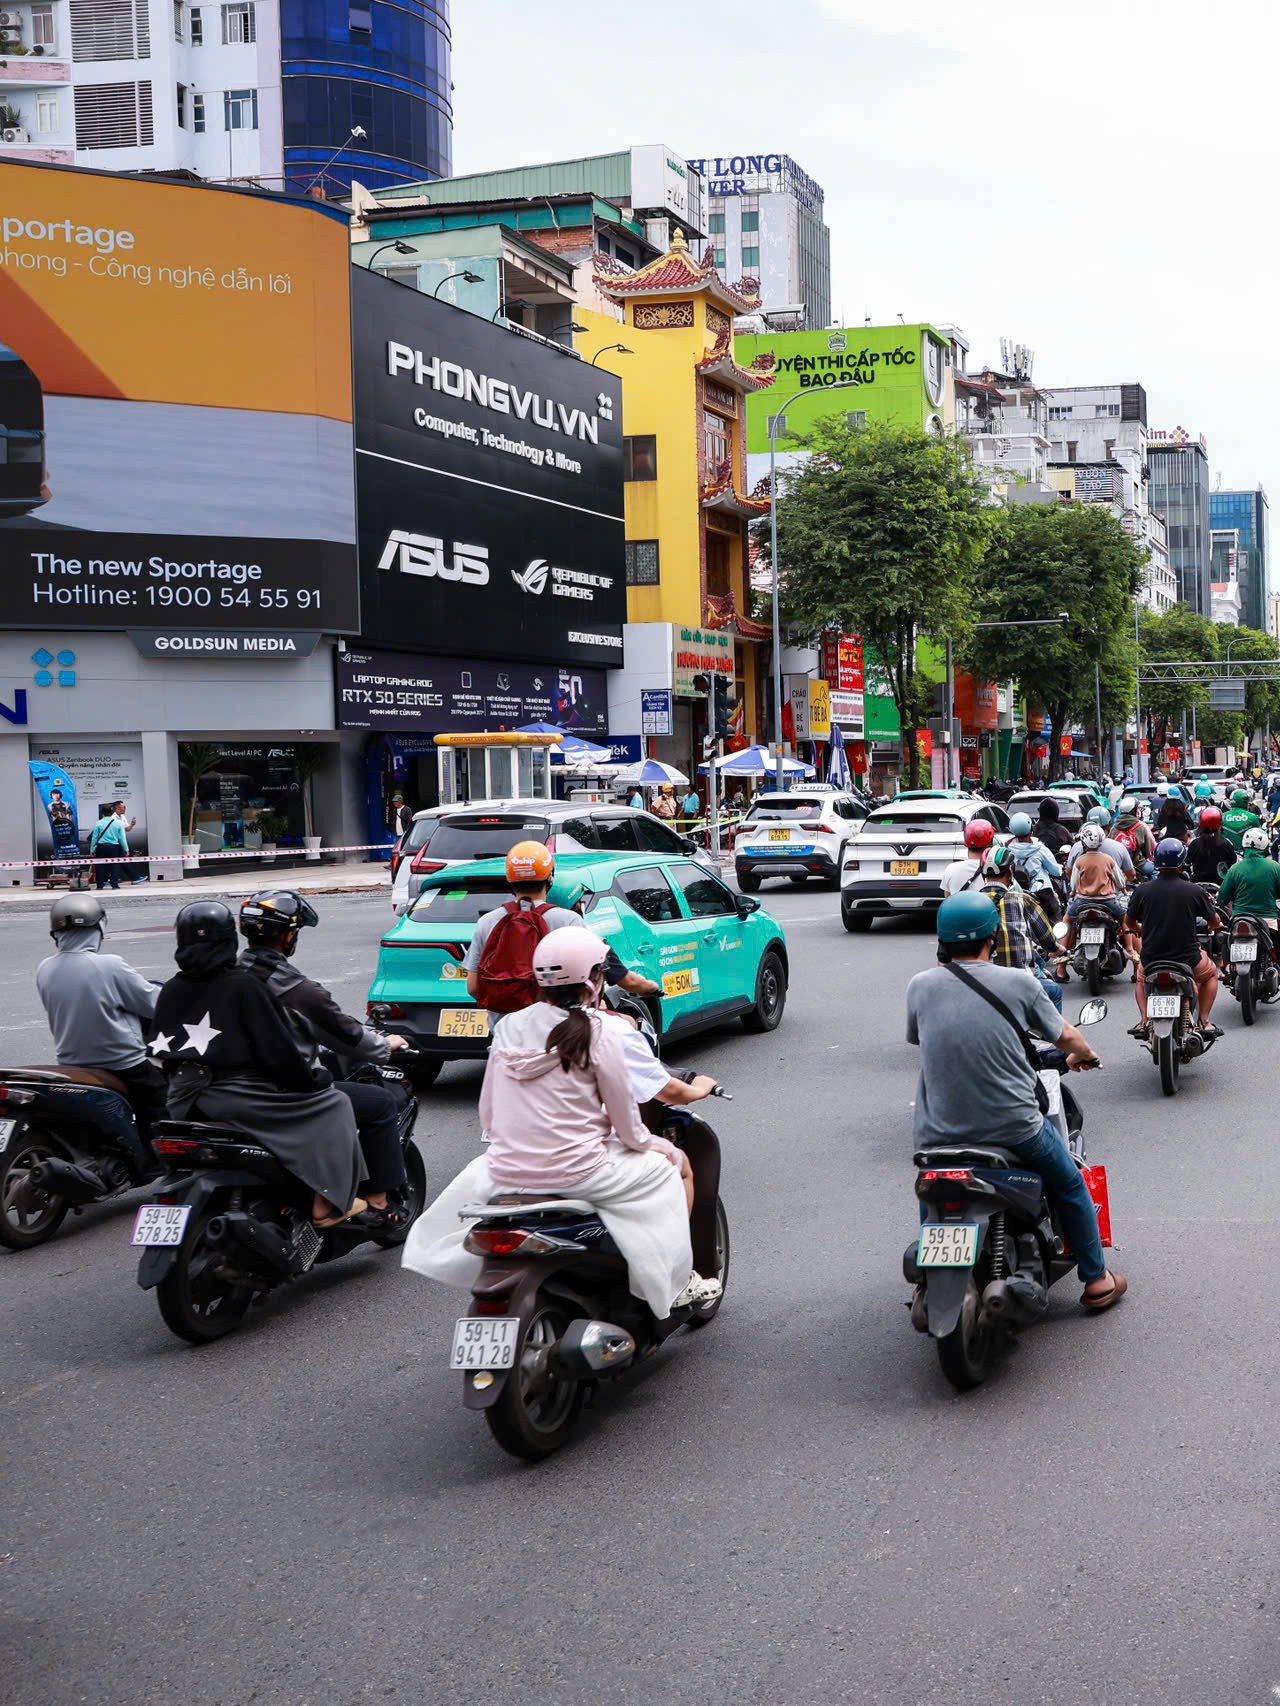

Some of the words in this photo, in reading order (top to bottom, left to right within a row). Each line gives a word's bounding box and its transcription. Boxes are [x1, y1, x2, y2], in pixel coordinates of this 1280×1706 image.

[714, 154, 781, 176] LONG
[0, 216, 135, 253] portage
[89, 255, 152, 285] Công
[159, 266, 215, 290] nghệ
[221, 266, 263, 293] dẫn
[269, 272, 292, 294] lối
[817, 355, 843, 370] THI
[846, 348, 879, 367] CẤP
[882, 346, 915, 366] TỐC
[800, 373, 836, 388] BAO
[388, 340, 599, 446] PHONGVU.VN
[414, 407, 478, 446] Computer,
[482, 427, 544, 467] Technology
[546, 449, 554, 465] &
[556, 451, 581, 474] More
[377, 529, 489, 586] ASUS
[31, 553, 85, 576] The
[88, 560, 142, 577] new
[149, 556, 262, 585] Sportage
[552, 568, 600, 586] REPUBLIC
[600, 576, 614, 589] OF
[33, 583, 137, 606] Hotline:
[146, 586, 211, 608] 1900
[220, 587, 251, 608] 54
[259, 588, 289, 608] 55
[297, 589, 321, 609] 91
[552, 583, 595, 601] GAMERS
[155, 637, 238, 652] GOLDSUN
[243, 638, 297, 652] MEDIA
[353, 675, 385, 685] LAPTOP
[387, 678, 415, 687] GAMING
[417, 680, 432, 688] ROG
[343, 689, 372, 703] RTX
[376, 691, 394, 704] 50
[397, 692, 443, 706] SERIES
[792, 689, 806, 698] CHÁO
[796, 702, 804, 711] VỊT
[796, 713, 803, 722] BÉ
[797, 724, 803, 733] BA
[1226, 813, 1248, 822] Grab
[676, 974, 691, 990] 50K
[1152, 998, 1175, 1007] 66-N8
[455, 1011, 477, 1023] 50E
[1152, 1007, 1175, 1017] 1550
[444, 1023, 484, 1035] 347.18
[144, 1209, 182, 1225] 59-U2
[135, 1225, 181, 1244] 578.25
[928, 1227, 967, 1244] 59-C1
[922, 1246, 972, 1264] 775.04
[464, 1322, 508, 1344] 59-L1
[455, 1344, 511, 1366] 941.28
